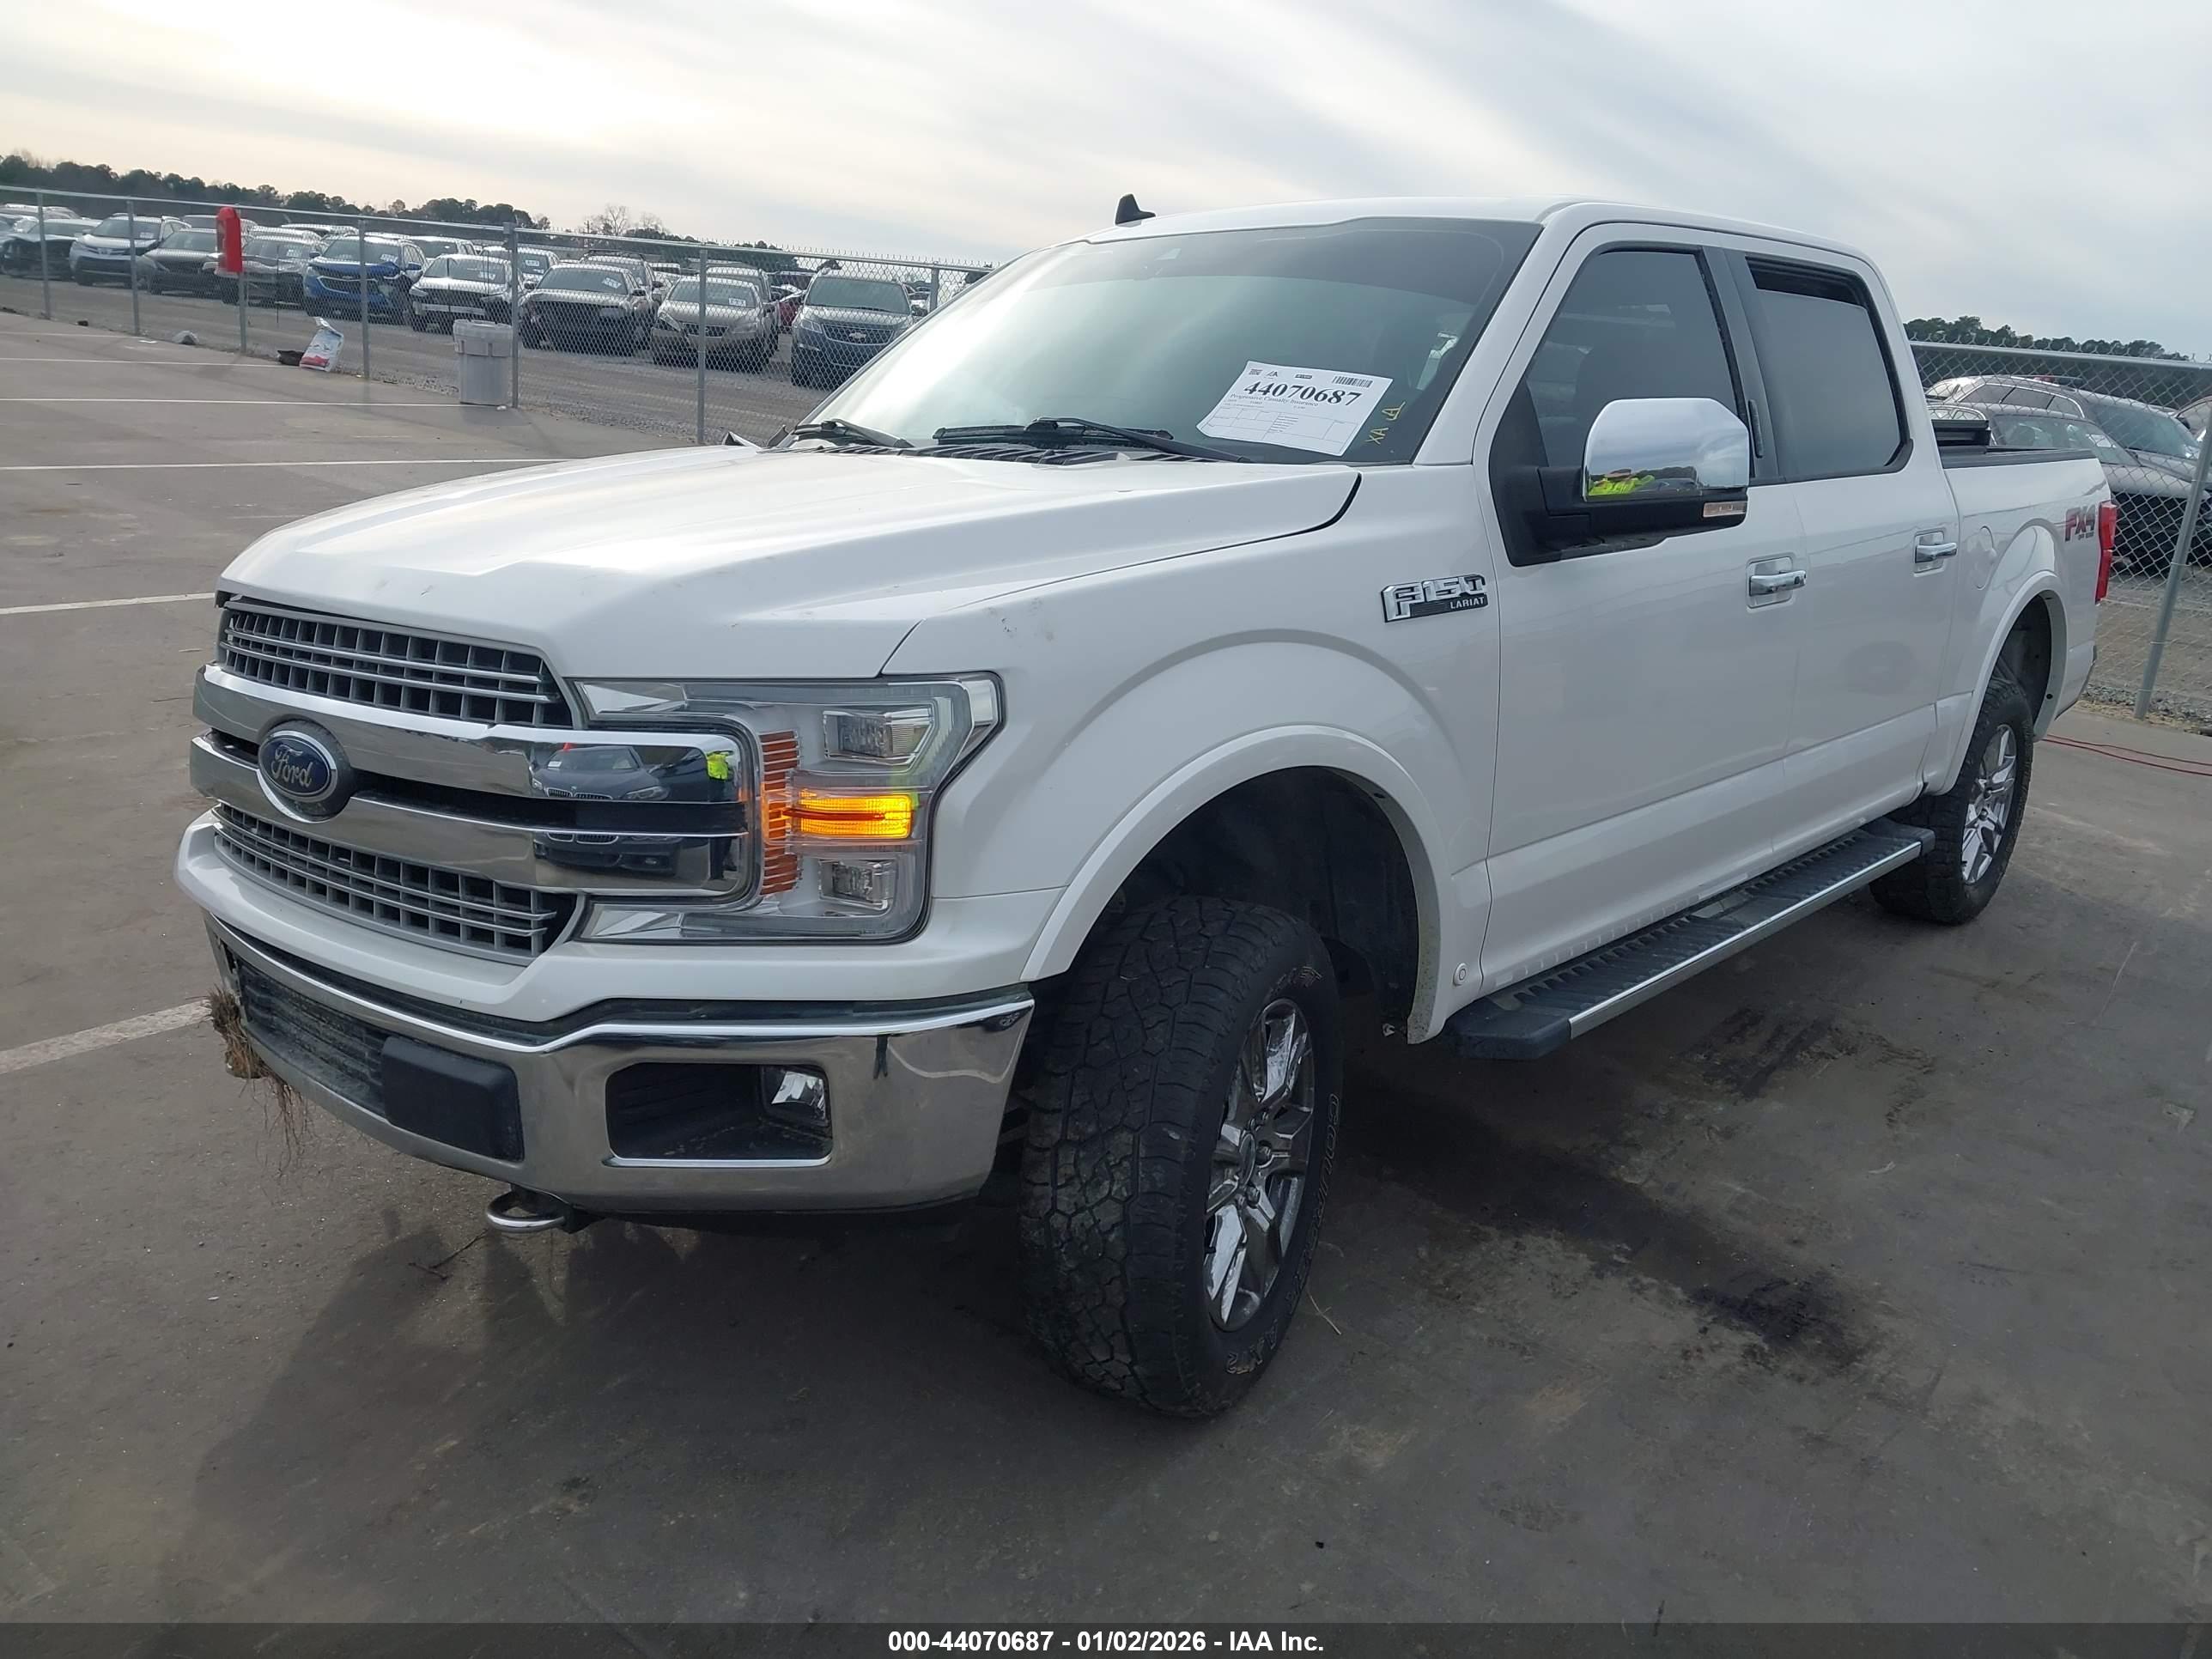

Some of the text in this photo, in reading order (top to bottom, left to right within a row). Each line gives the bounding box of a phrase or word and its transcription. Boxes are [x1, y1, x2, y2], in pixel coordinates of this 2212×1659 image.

[1244, 380, 1362, 406] 44070687
[1291, 398, 1319, 407] Insurance
[2064, 504, 2096, 541] FX4
[1449, 596, 1485, 610] LARIAT
[270, 744, 313, 788] Ford
